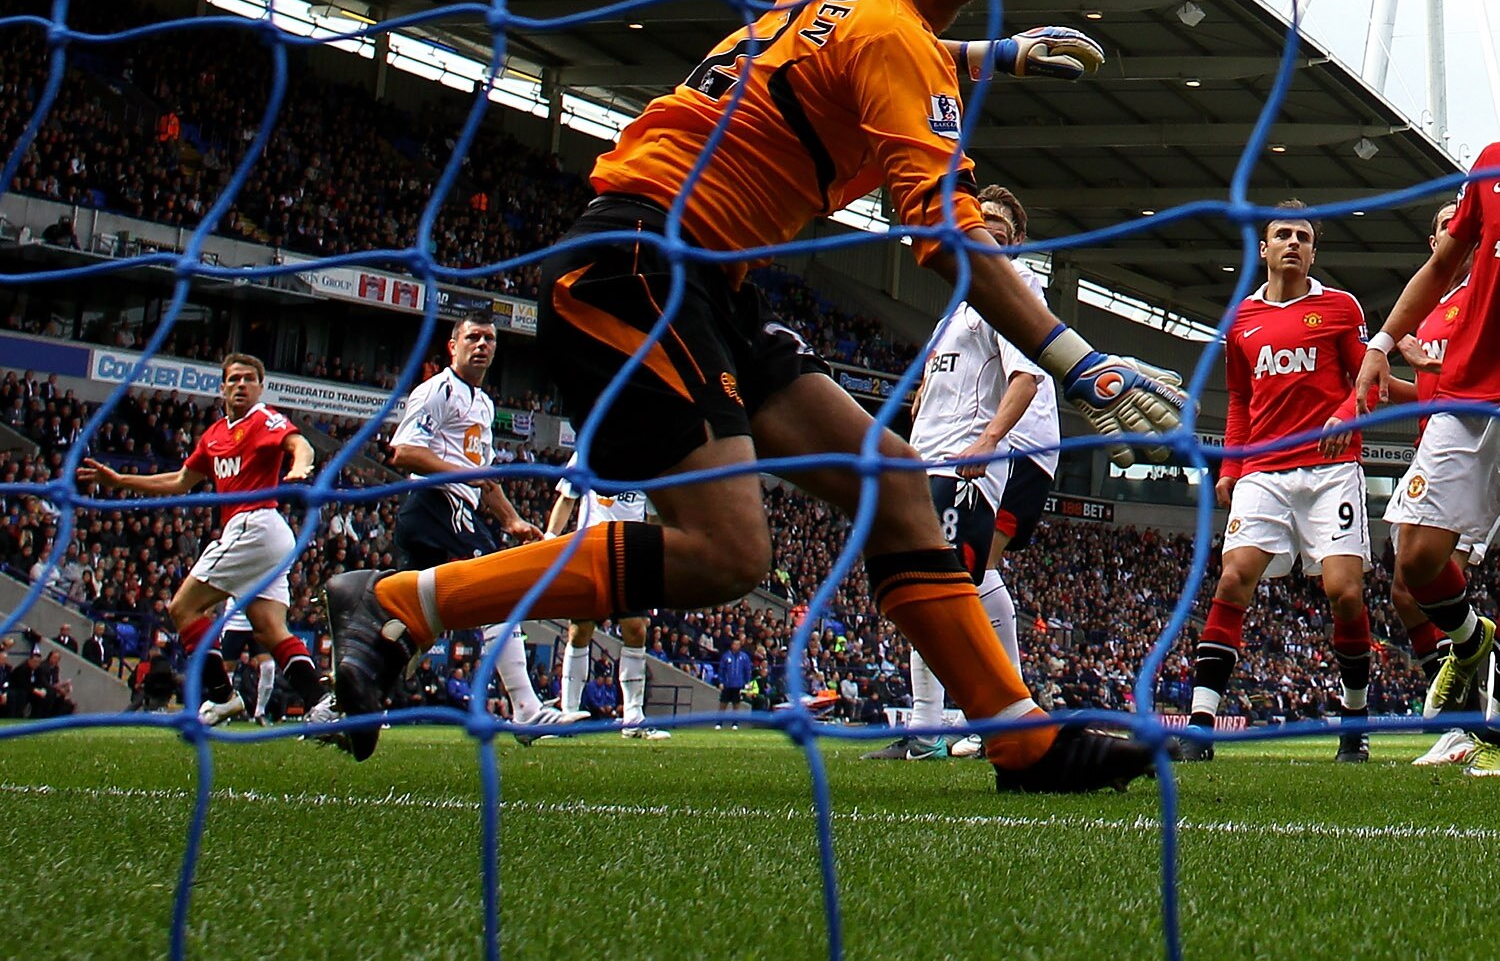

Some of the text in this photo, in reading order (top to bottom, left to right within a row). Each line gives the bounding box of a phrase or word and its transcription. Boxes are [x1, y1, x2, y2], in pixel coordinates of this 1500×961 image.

[322, 275, 352, 291] GROUP
[1254, 345, 1317, 380] AON
[1418, 339, 1448, 363] ON
[268, 381, 335, 400] REFRIGERATED
[337, 391, 389, 408] TRANSPORT
[1361, 447, 1415, 462] Sales@
[1062, 500, 1105, 520] 188BET
[1338, 502, 1354, 531] 9
